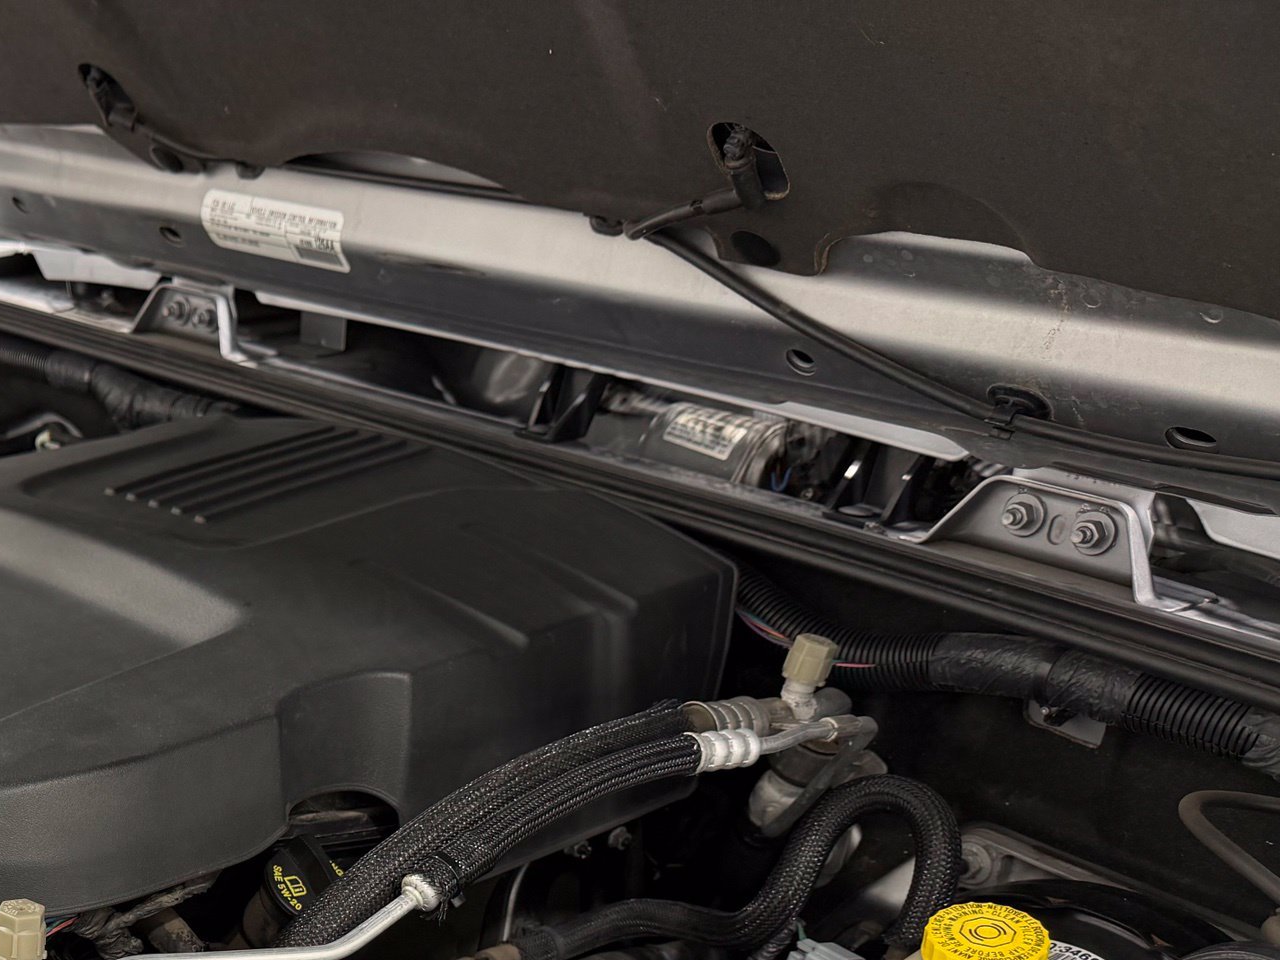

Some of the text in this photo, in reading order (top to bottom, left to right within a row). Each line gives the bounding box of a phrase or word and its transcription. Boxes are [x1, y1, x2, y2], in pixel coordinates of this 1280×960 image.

[273, 864, 303, 911] SAE 5W-20
[963, 947, 1004, 958] BEFORE
